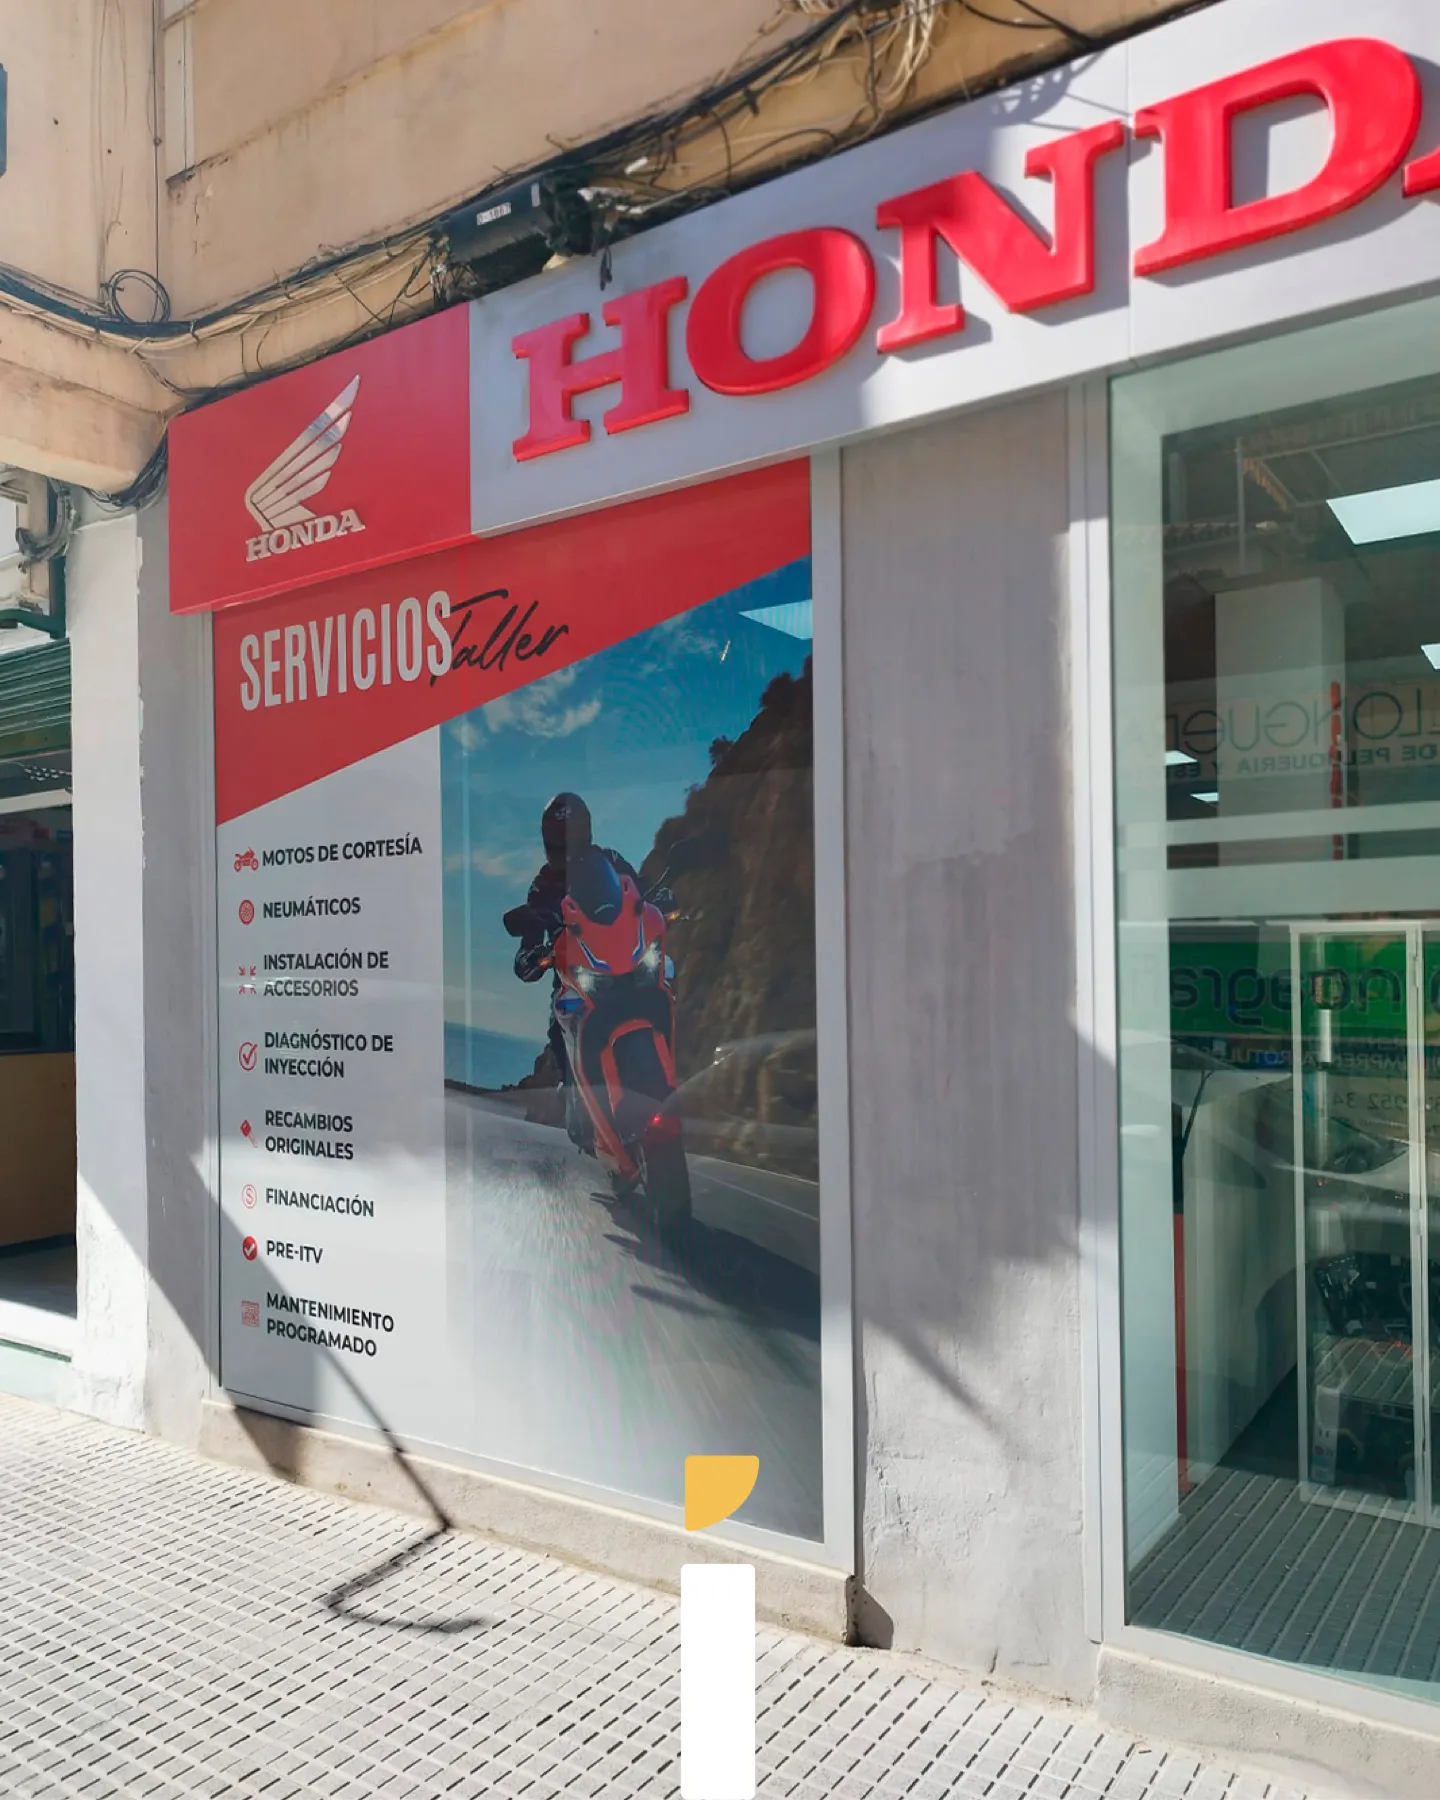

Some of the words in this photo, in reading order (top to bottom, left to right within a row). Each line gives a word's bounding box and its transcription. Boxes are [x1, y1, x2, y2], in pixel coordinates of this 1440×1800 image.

[511, 37, 1440, 463] HOND
[245, 508, 366, 563] HONDA
[240, 590, 453, 711] SERVICIOS
[430, 588, 568, 688] Taller
[262, 846, 314, 867] MOTOS
[318, 844, 338, 863] DE
[342, 833, 423, 860] CORTESÍA
[263, 895, 362, 919] NEUMÁTICOS
[264, 947, 362, 970] INSTALACIÓN
[367, 950, 389, 969] DE
[263, 978, 359, 997] ACCESORIOS
[264, 1029, 367, 1052] DIAGNÓSTICO
[372, 1034, 393, 1052] DE
[264, 1056, 345, 1078] INYECCIÓN
[265, 1110, 354, 1133] RECAMBIOS
[265, 1135, 354, 1160] ORIGINALES
[265, 1187, 375, 1218] FINANCIACIÓN
[266, 1239, 324, 1265] PRE-ITV
[266, 1291, 395, 1333] MANTENIMIENTO
[266, 1317, 378, 1357] PROGRAMADO
